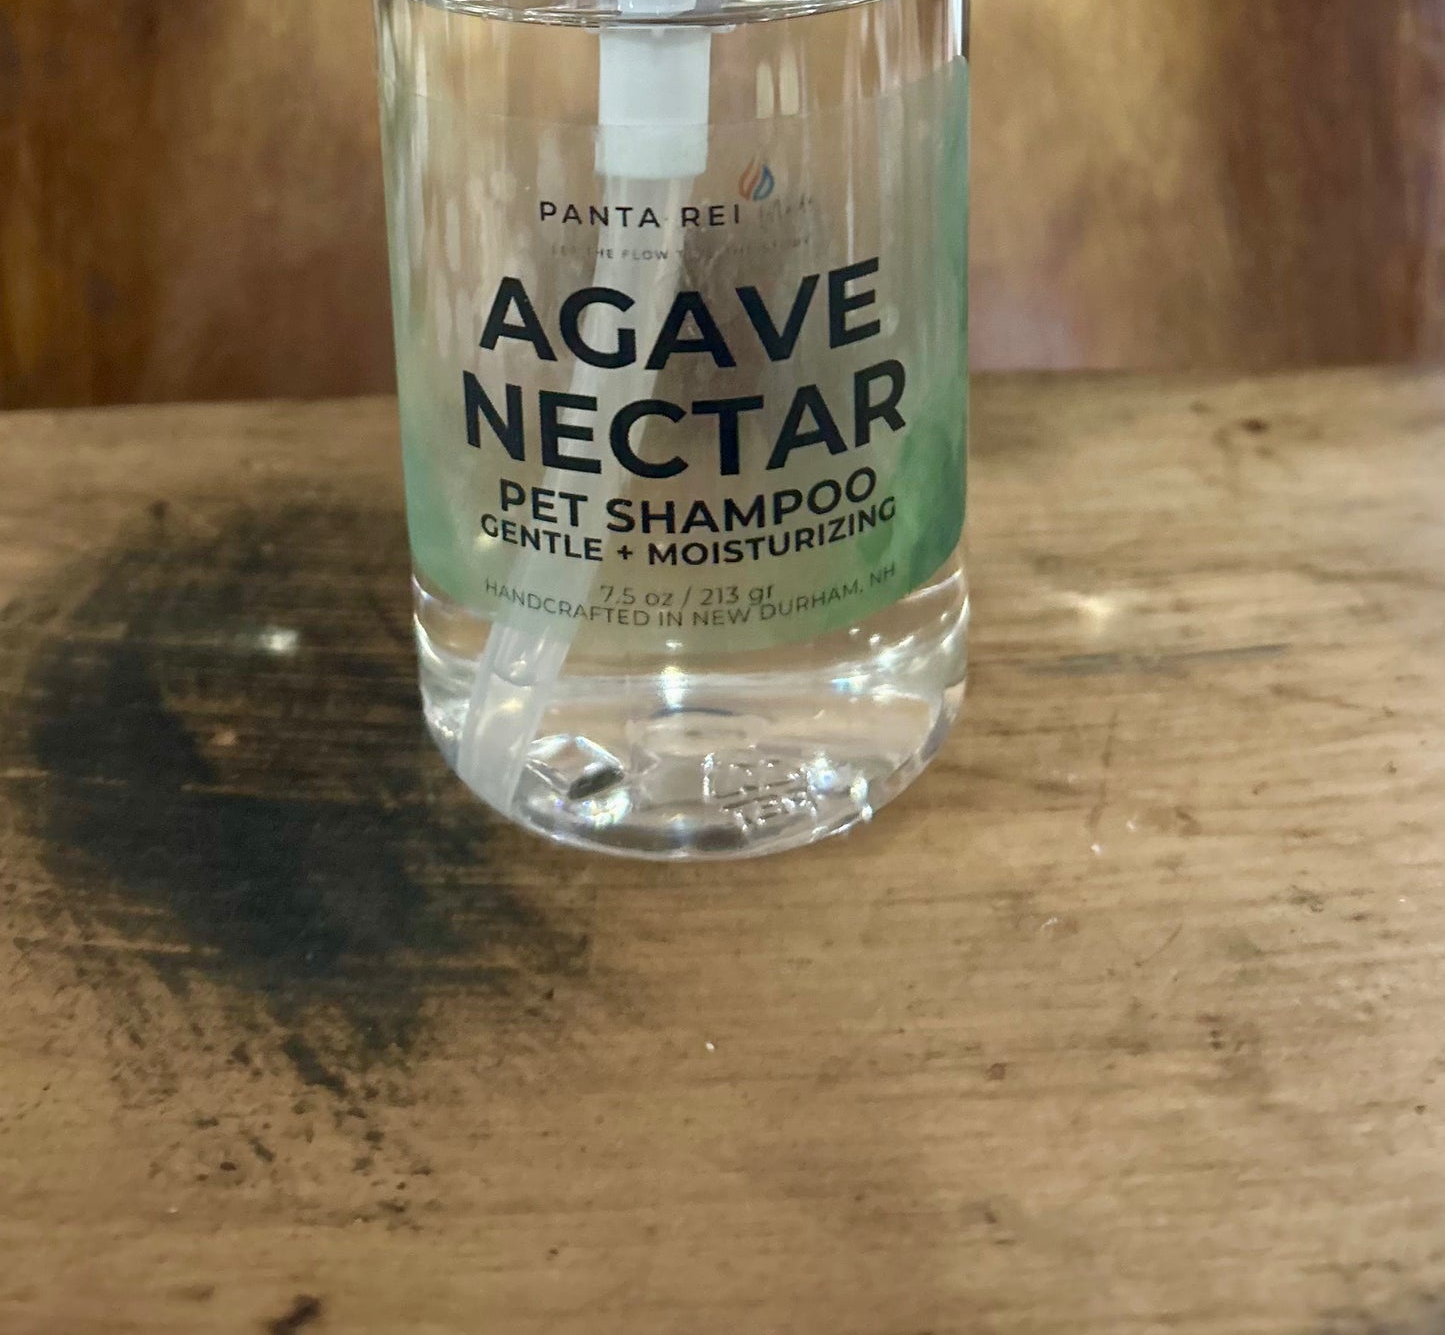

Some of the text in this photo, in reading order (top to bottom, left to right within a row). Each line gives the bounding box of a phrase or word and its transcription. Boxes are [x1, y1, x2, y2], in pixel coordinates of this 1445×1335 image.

[539, 200, 661, 228] PANTA
[681, 203, 740, 228] REI
[622, 247, 670, 261] FLOW
[478, 257, 882, 371] AGAVE
[462, 359, 907, 479] NECTAR
[481, 496, 896, 566] GENTLE + MOISTURIZING
[500, 466, 877, 534] PET SHAMPOO
[486, 561, 896, 627] HANDCRAFTED IN NEW DURHAM, NH
[600, 583, 775, 608] 7.5 oz / 213 gr
